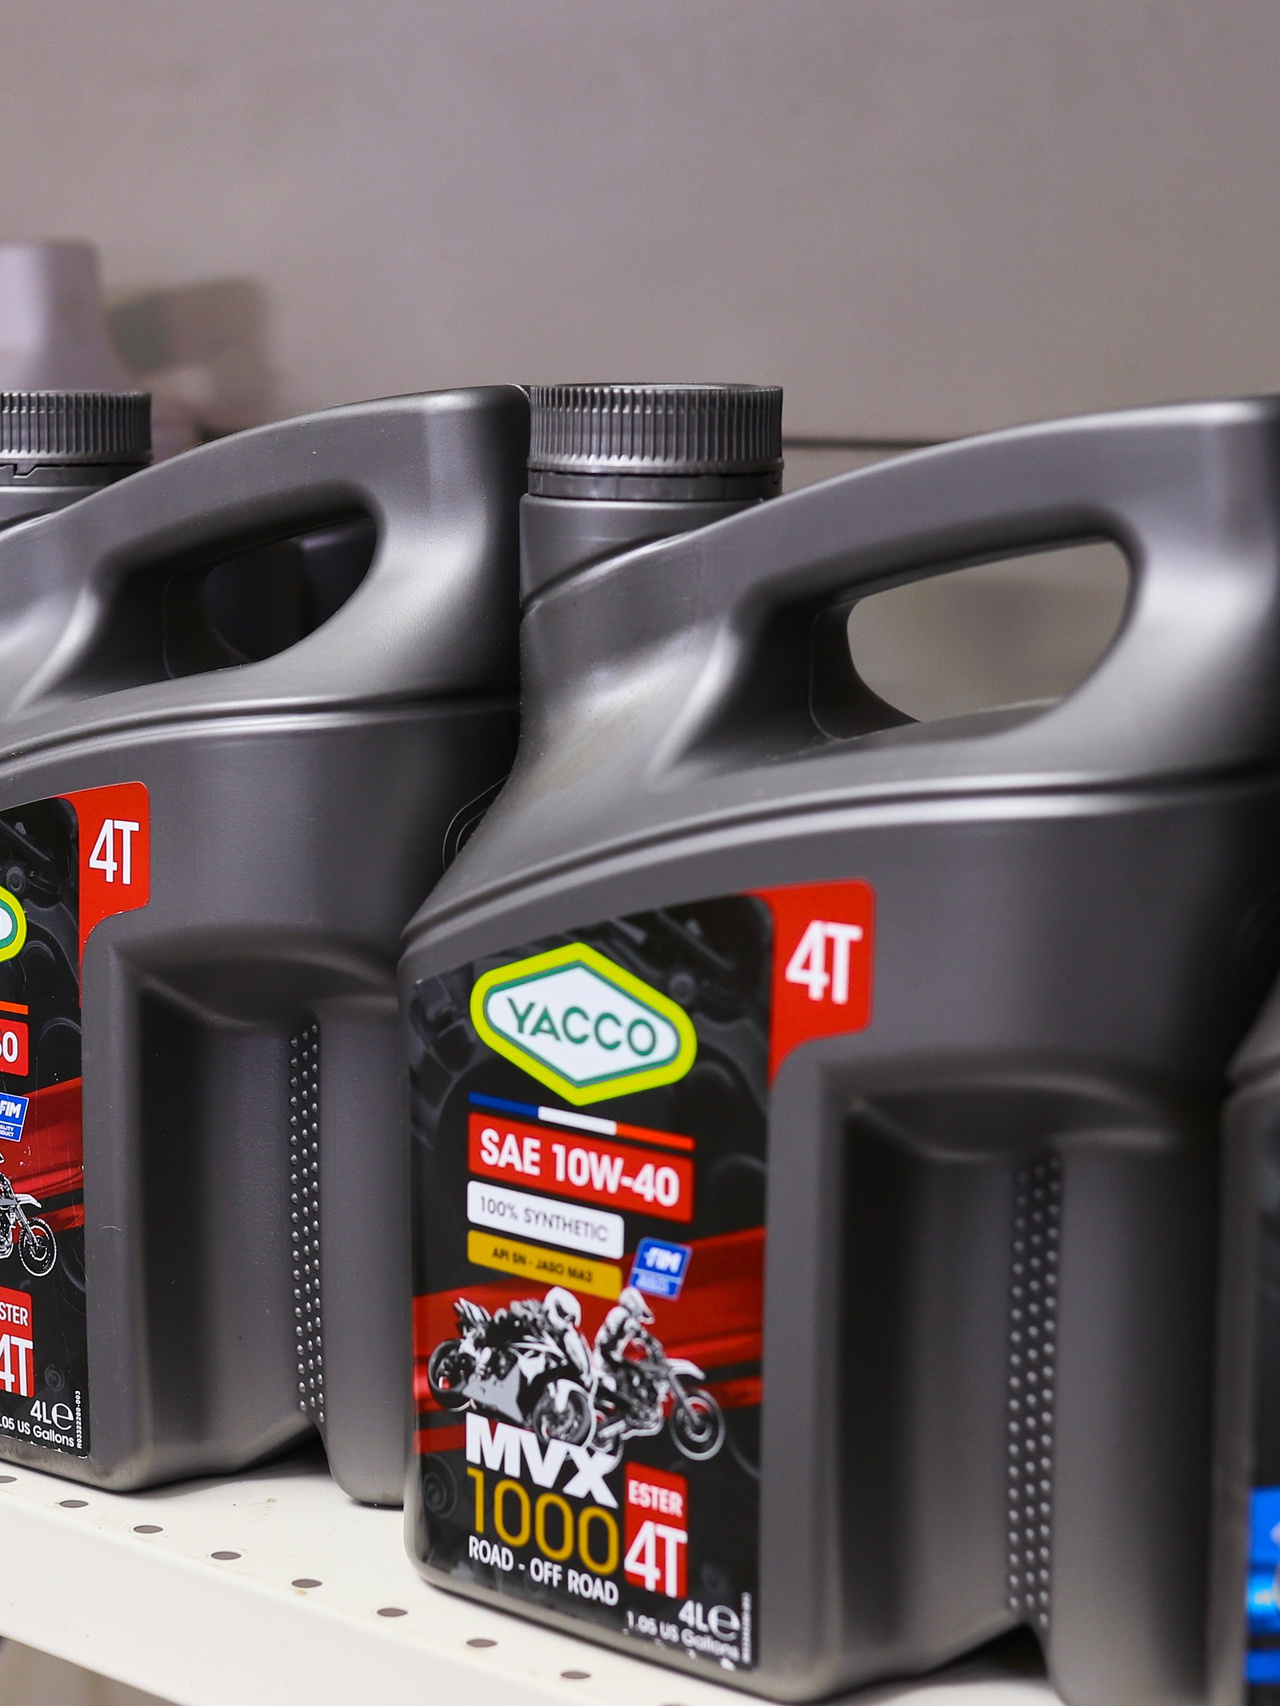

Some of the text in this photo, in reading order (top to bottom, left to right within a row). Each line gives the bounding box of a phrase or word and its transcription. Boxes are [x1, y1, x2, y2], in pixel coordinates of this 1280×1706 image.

[89, 819, 140, 885] 4T
[786, 920, 863, 1005] 4T
[507, 996, 657, 1057] YACCO
[480, 1128, 680, 1208] SAE 10W-40
[480, 1196, 608, 1242] 100% SYNTHETIC
[492, 1247, 509, 1260] API
[17, 1419, 31, 1436] US
[32, 1425, 75, 1448] Gallons
[465, 1411, 618, 1508] MVX
[627, 1480, 683, 1518] ESTER
[466, 1467, 688, 1598] 1000 4T
[469, 1535, 514, 1572] ROAD
[530, 1558, 563, 1588] OFF
[568, 1569, 619, 1607] ROAD
[626, 1610, 741, 1662] 1.05 US Gallons
